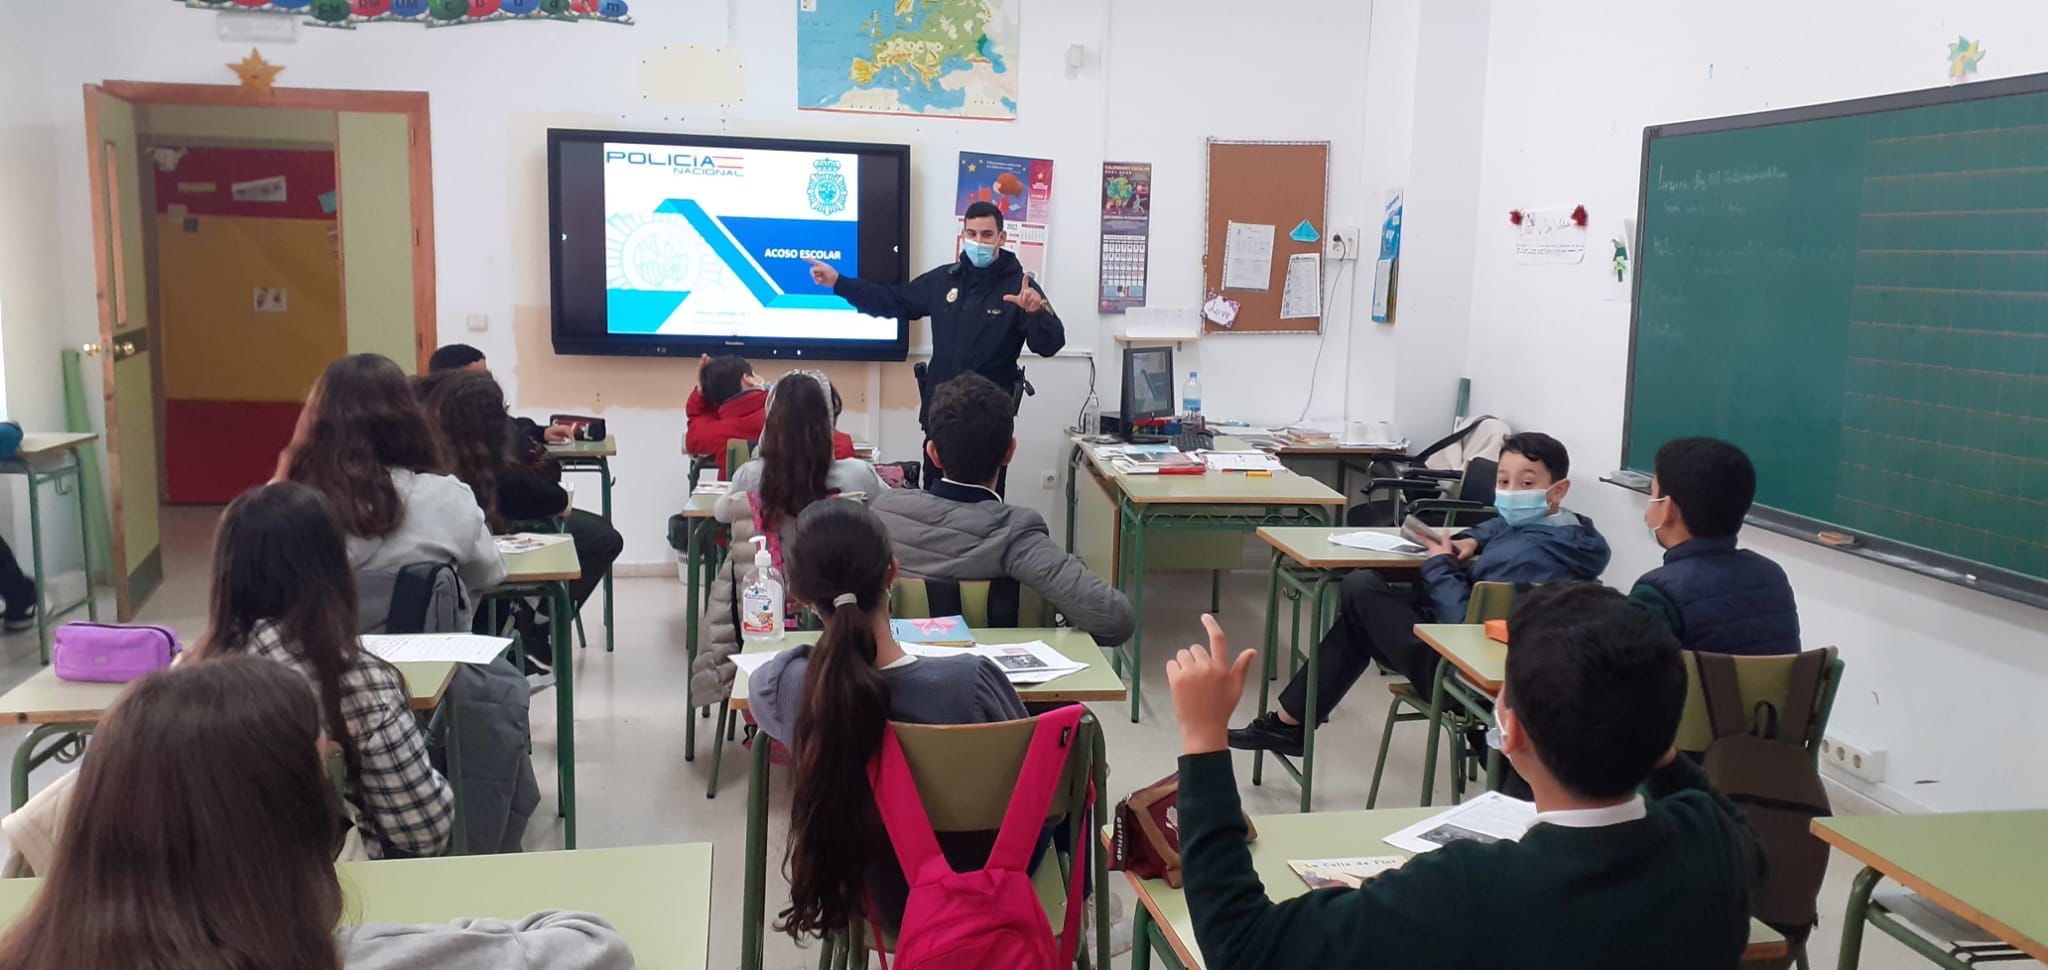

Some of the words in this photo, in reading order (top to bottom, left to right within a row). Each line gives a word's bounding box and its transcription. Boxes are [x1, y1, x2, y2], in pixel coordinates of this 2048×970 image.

[673, 167, 744, 178] NACIONAL
[764, 248, 798, 259] ACOSO
[800, 250, 841, 260] ESCOLAR
